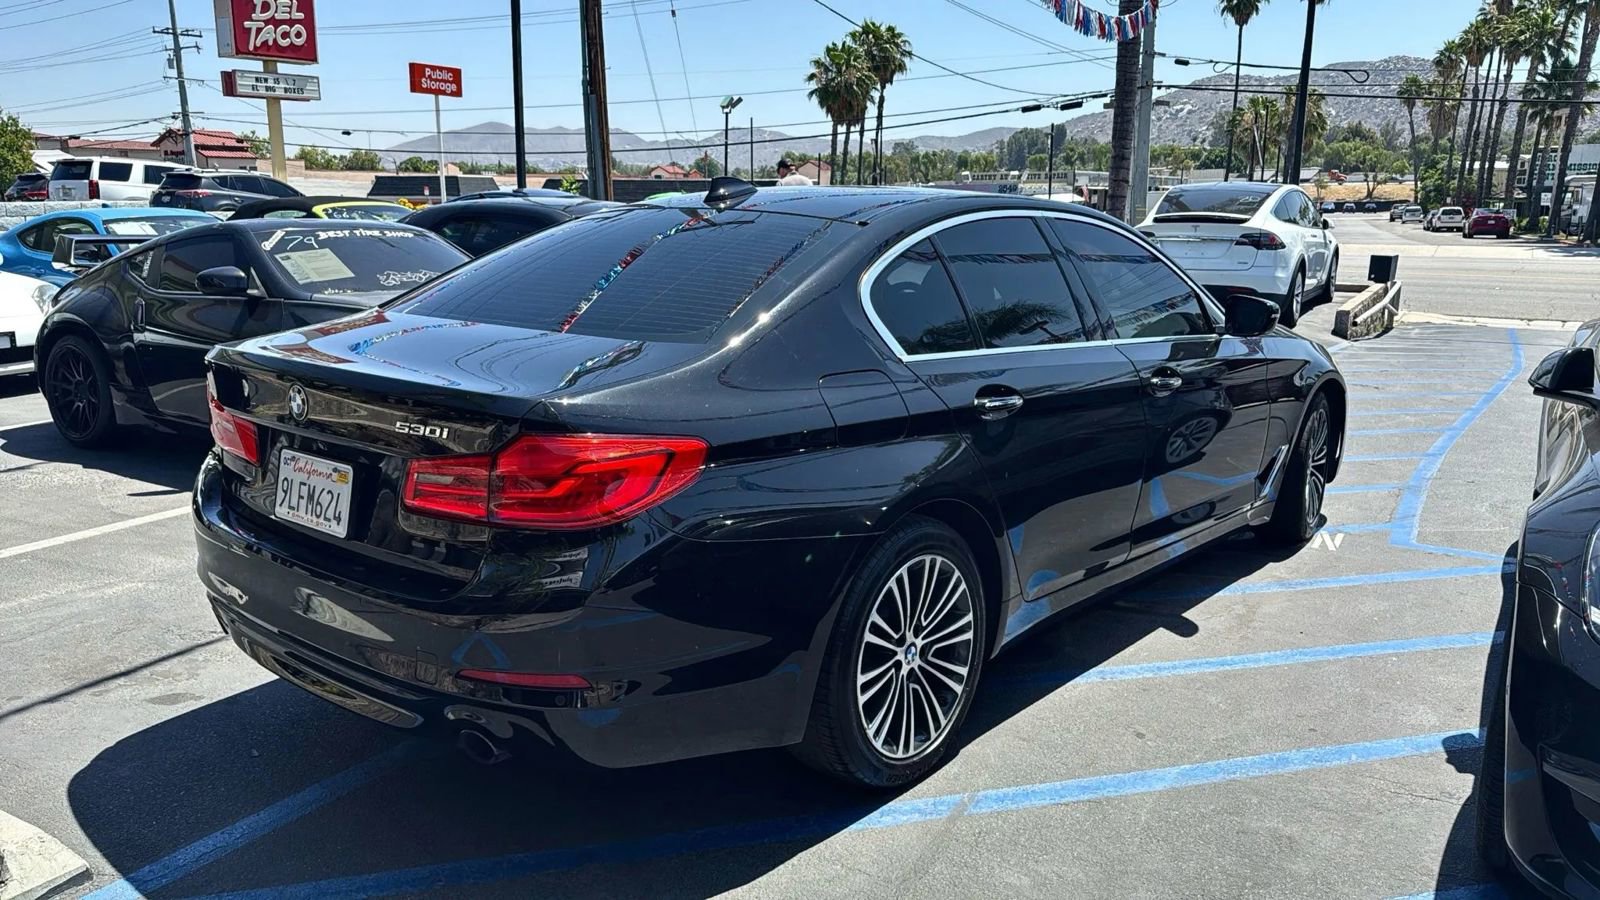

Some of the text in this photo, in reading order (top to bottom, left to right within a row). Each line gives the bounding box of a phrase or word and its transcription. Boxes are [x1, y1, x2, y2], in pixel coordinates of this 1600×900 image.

[251, 0, 304, 20] DEL
[243, 21, 307, 51] TACO
[254, 76, 269, 84] NEW
[425, 67, 454, 81] Public
[264, 85, 276, 93] BIG
[283, 86, 305, 95] BOXES
[421, 77, 457, 94] Storage
[284, 235, 318, 250] 79
[315, 230, 351, 240] BEST
[384, 230, 415, 238] SHOP
[294, 458, 336, 482] California
[279, 477, 342, 526] 9LFM624
